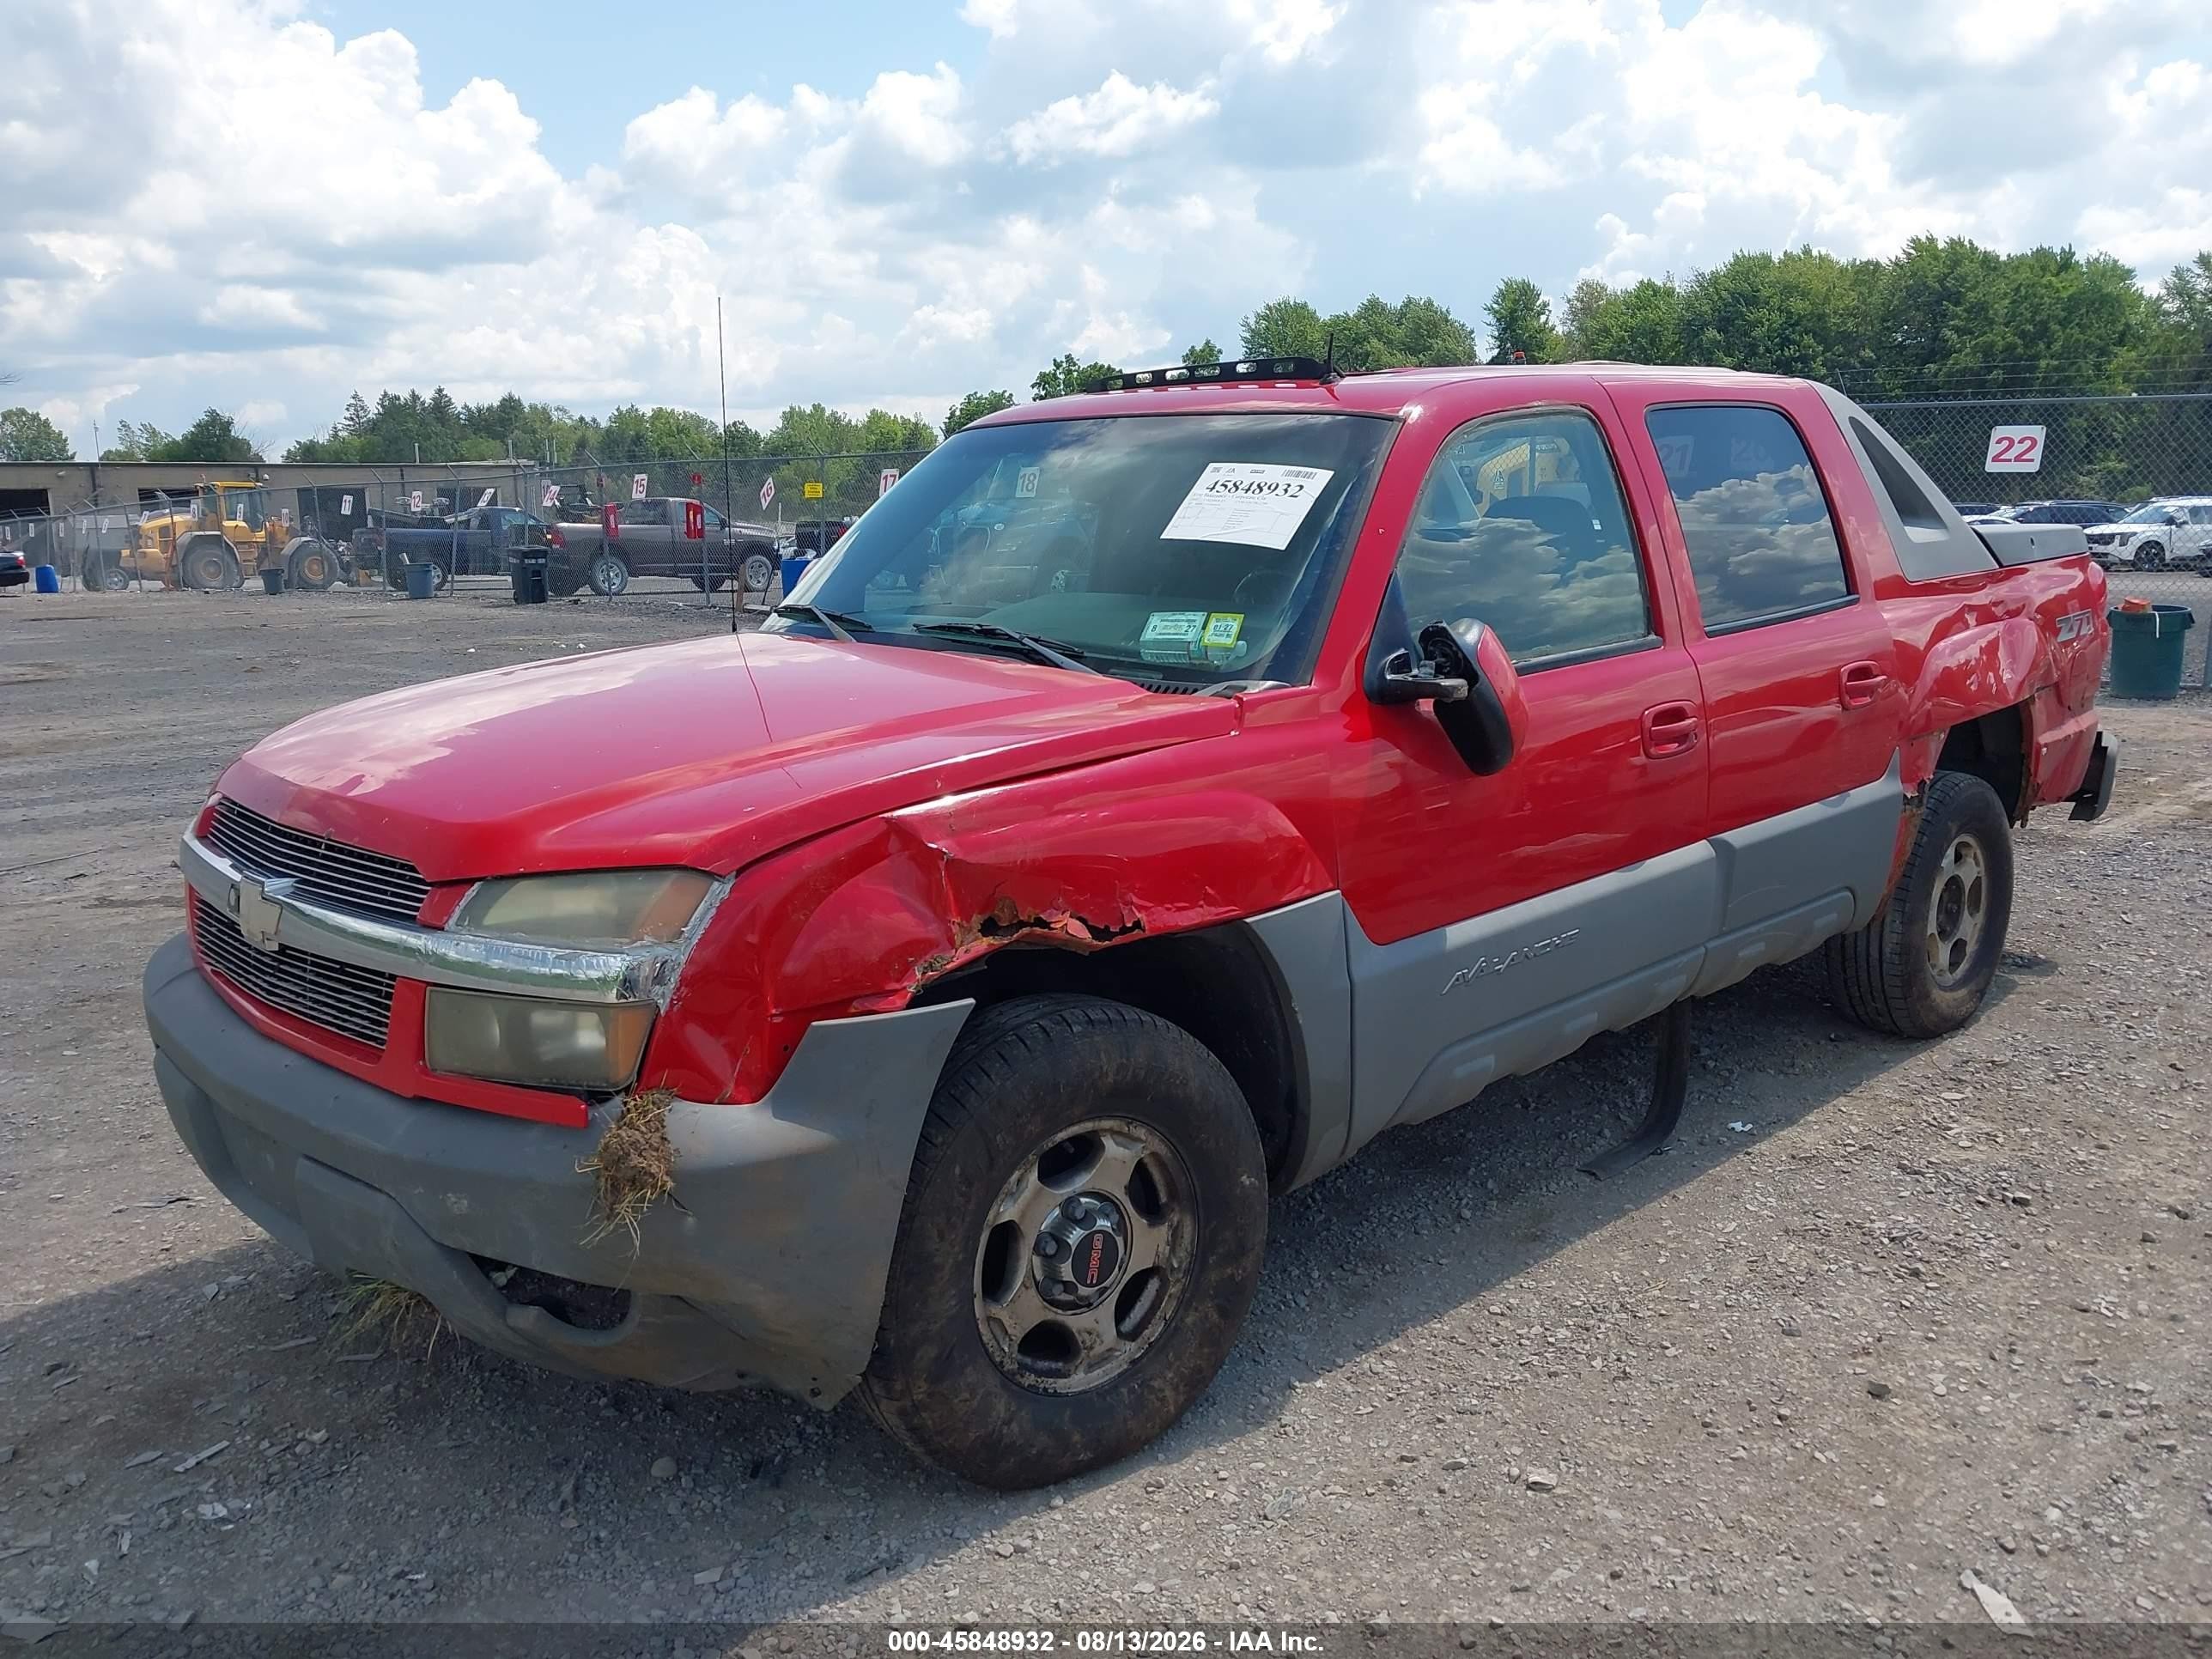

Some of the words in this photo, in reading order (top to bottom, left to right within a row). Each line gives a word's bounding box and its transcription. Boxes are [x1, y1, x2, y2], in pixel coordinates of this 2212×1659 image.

[1660, 443, 1690, 471] 21
[1991, 435, 2039, 463] 22
[635, 478, 646, 495] 15
[761, 482, 773, 503] 16
[882, 474, 897, 493] 17
[1019, 472, 1037, 494] 18
[1205, 479, 1305, 499] 45848932
[343, 498, 351, 512] 11
[413, 495, 421, 508] 12
[481, 489, 492, 505] 13
[545, 488, 558, 503] 14
[1151, 624, 1158, 633] 8
[1184, 624, 1197, 633] 27
[2056, 609, 2094, 642] Z71
[1086, 1233, 1103, 1285] GMC
